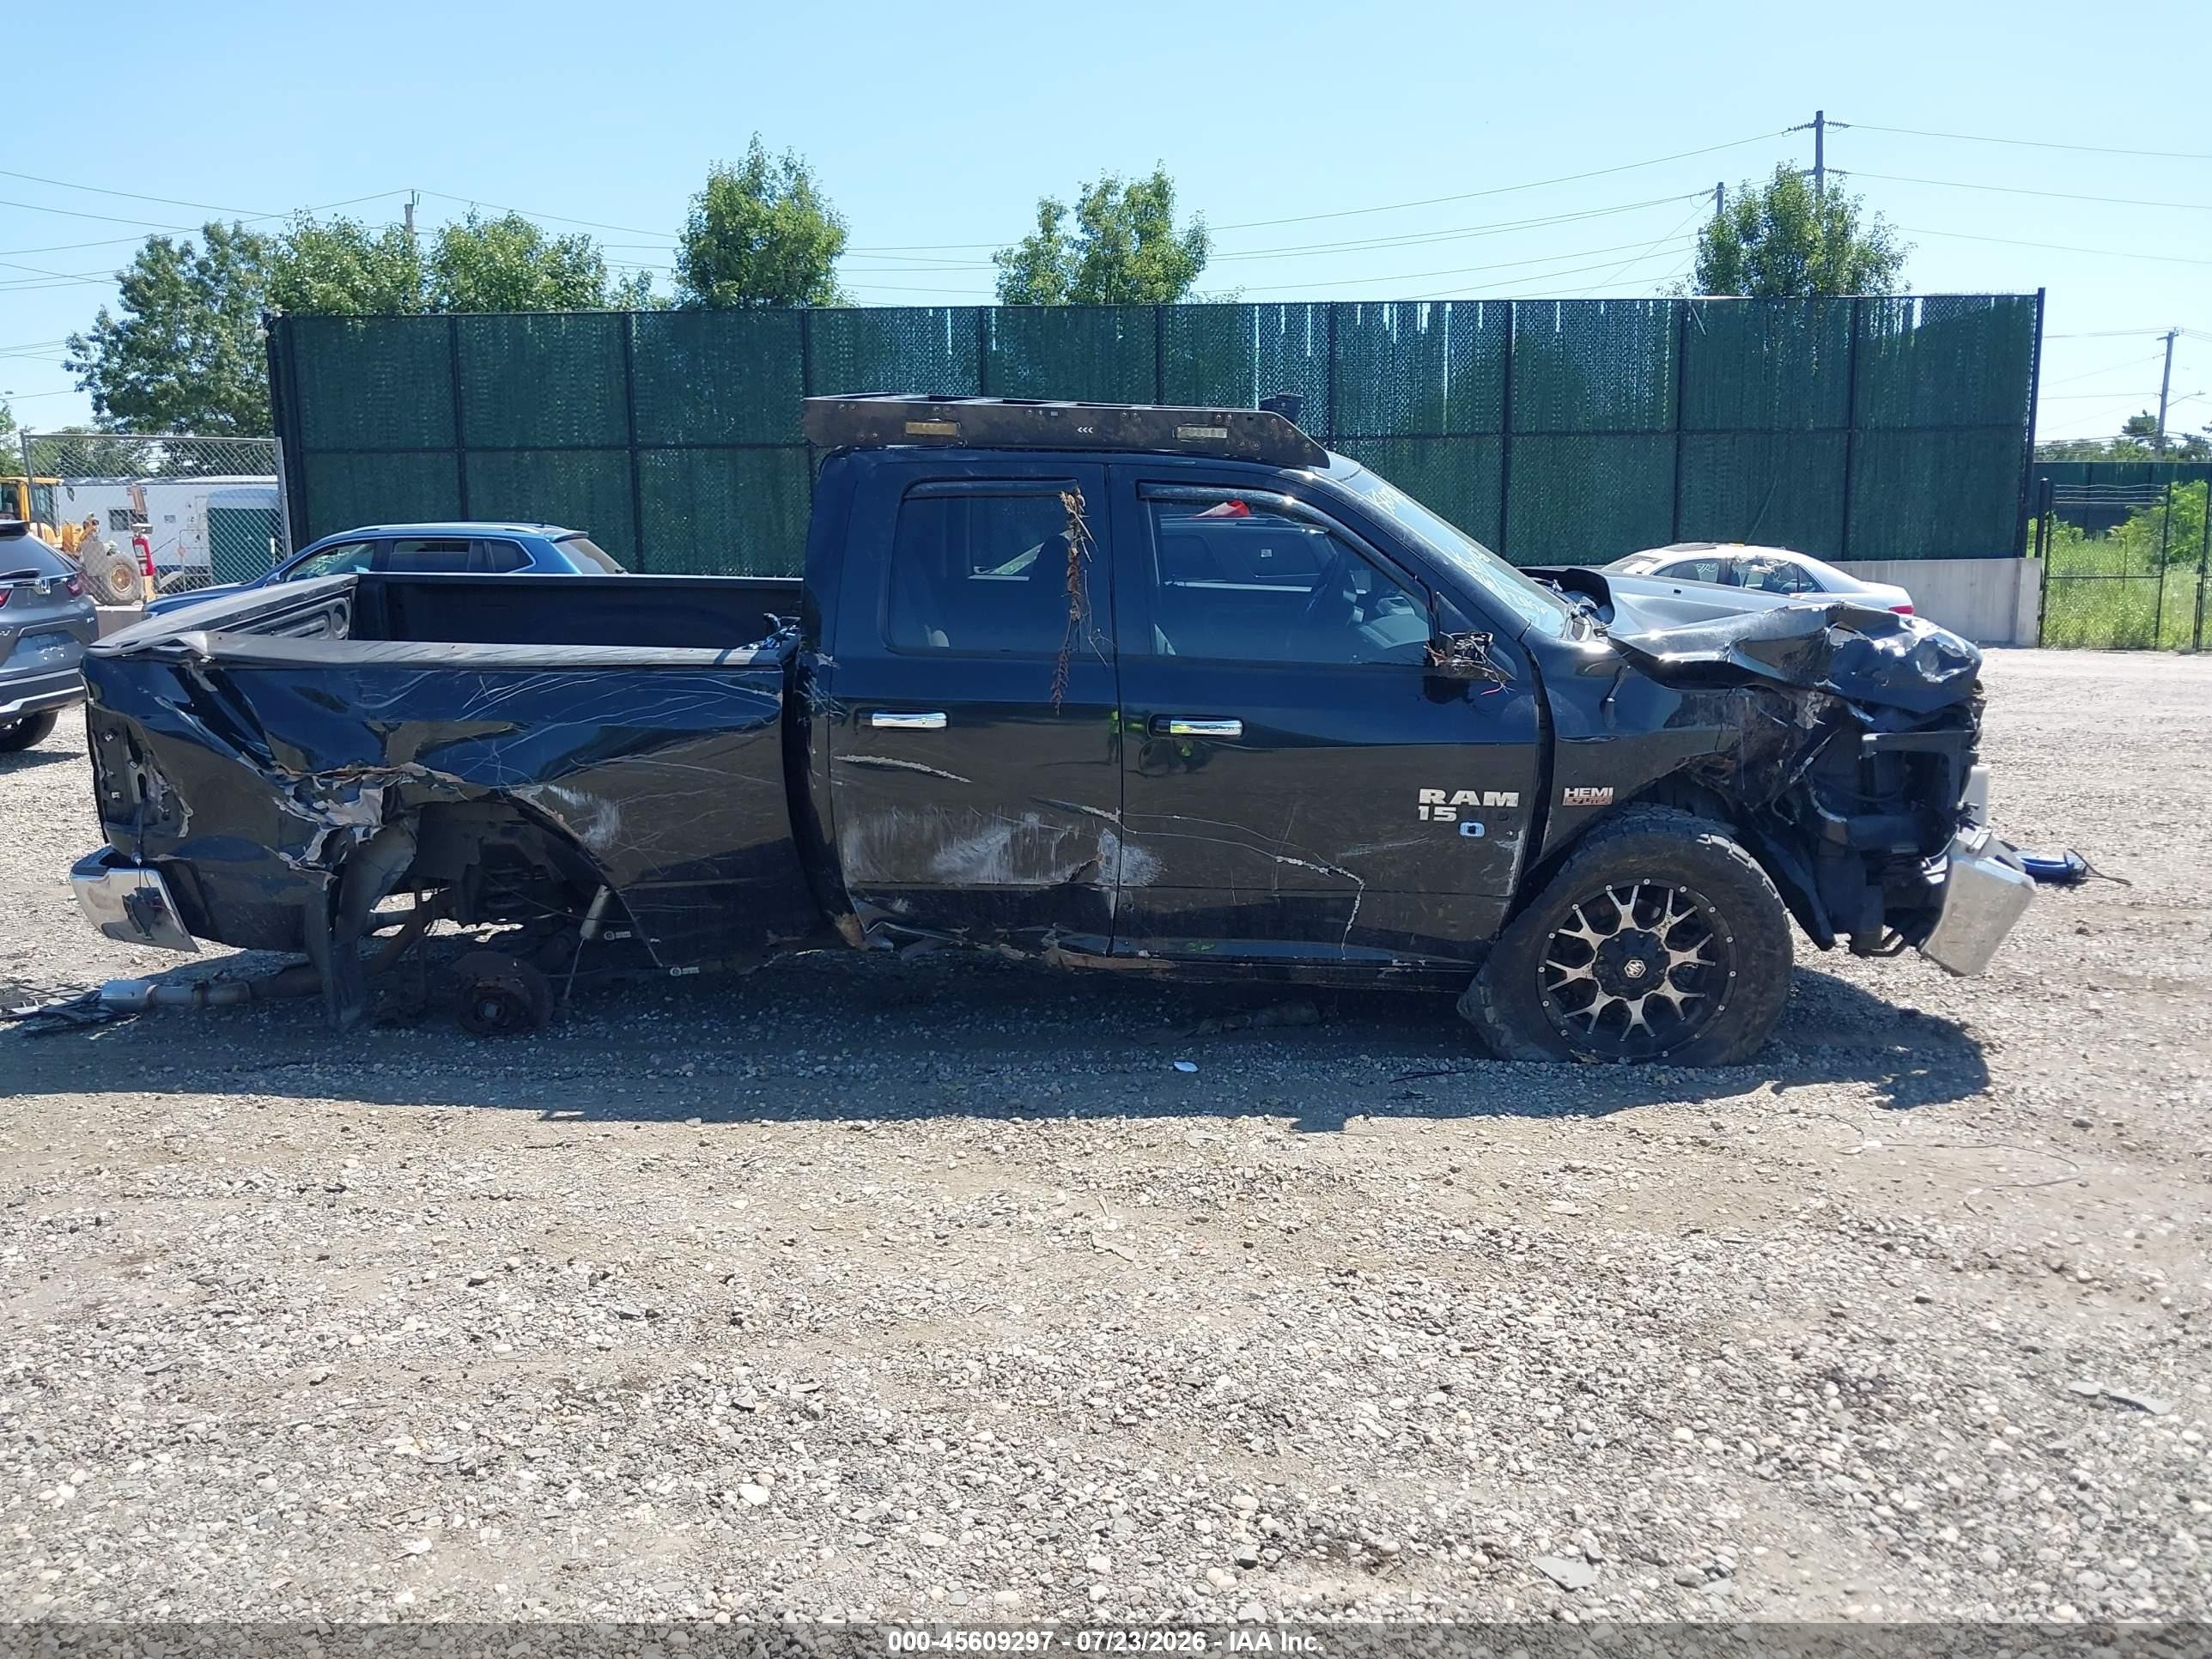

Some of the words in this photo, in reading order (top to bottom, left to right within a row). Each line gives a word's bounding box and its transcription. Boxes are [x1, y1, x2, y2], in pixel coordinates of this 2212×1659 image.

[1419, 787, 1520, 808] RAM
[1565, 787, 1614, 797] HEMI
[1418, 805, 1457, 822] 15
